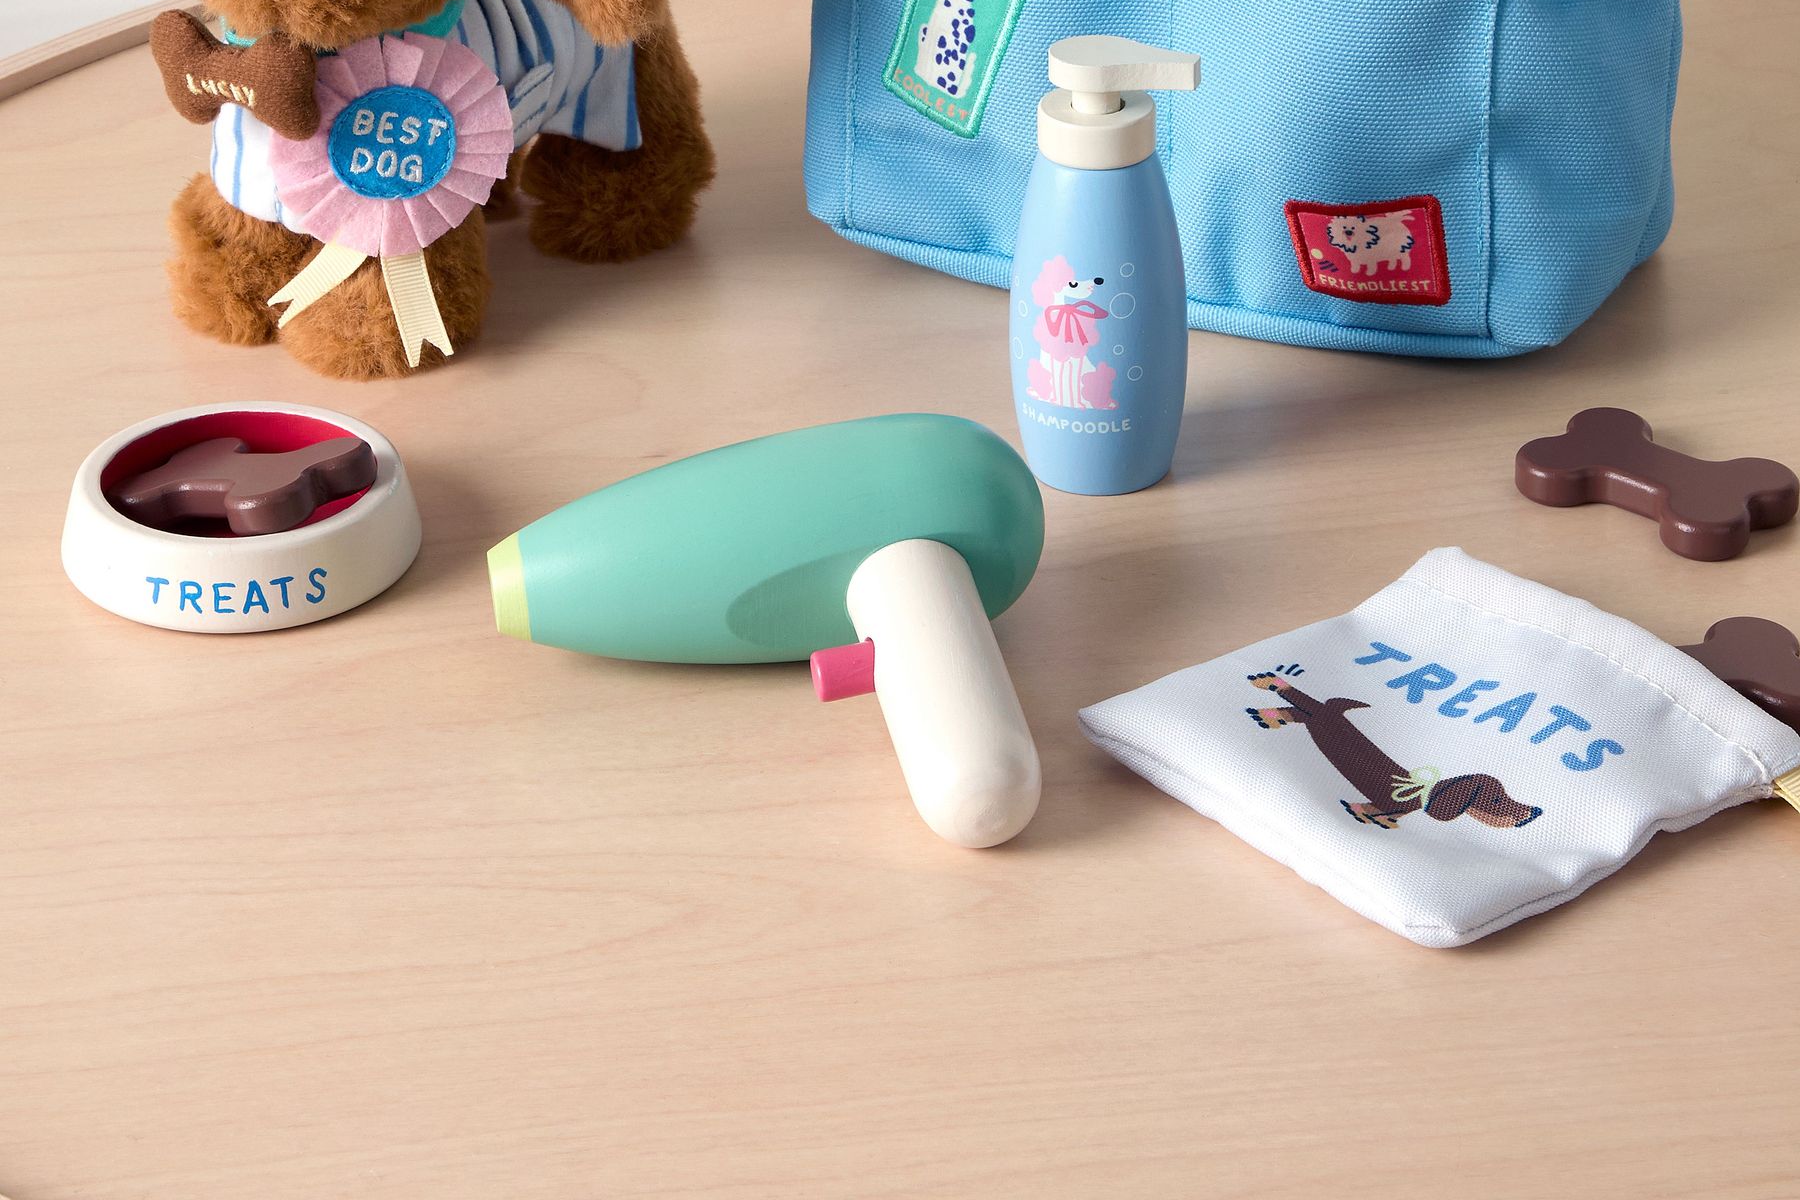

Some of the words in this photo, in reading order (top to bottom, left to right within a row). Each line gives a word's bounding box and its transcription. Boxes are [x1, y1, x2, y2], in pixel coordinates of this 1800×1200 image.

[893, 68, 970, 121] COOLEST
[352, 108, 448, 146] BEST
[349, 147, 424, 183] DOG
[1022, 402, 1132, 434] SHAMPOODLE
[145, 567, 328, 615] TREATS
[1354, 641, 1624, 772] TREATS
